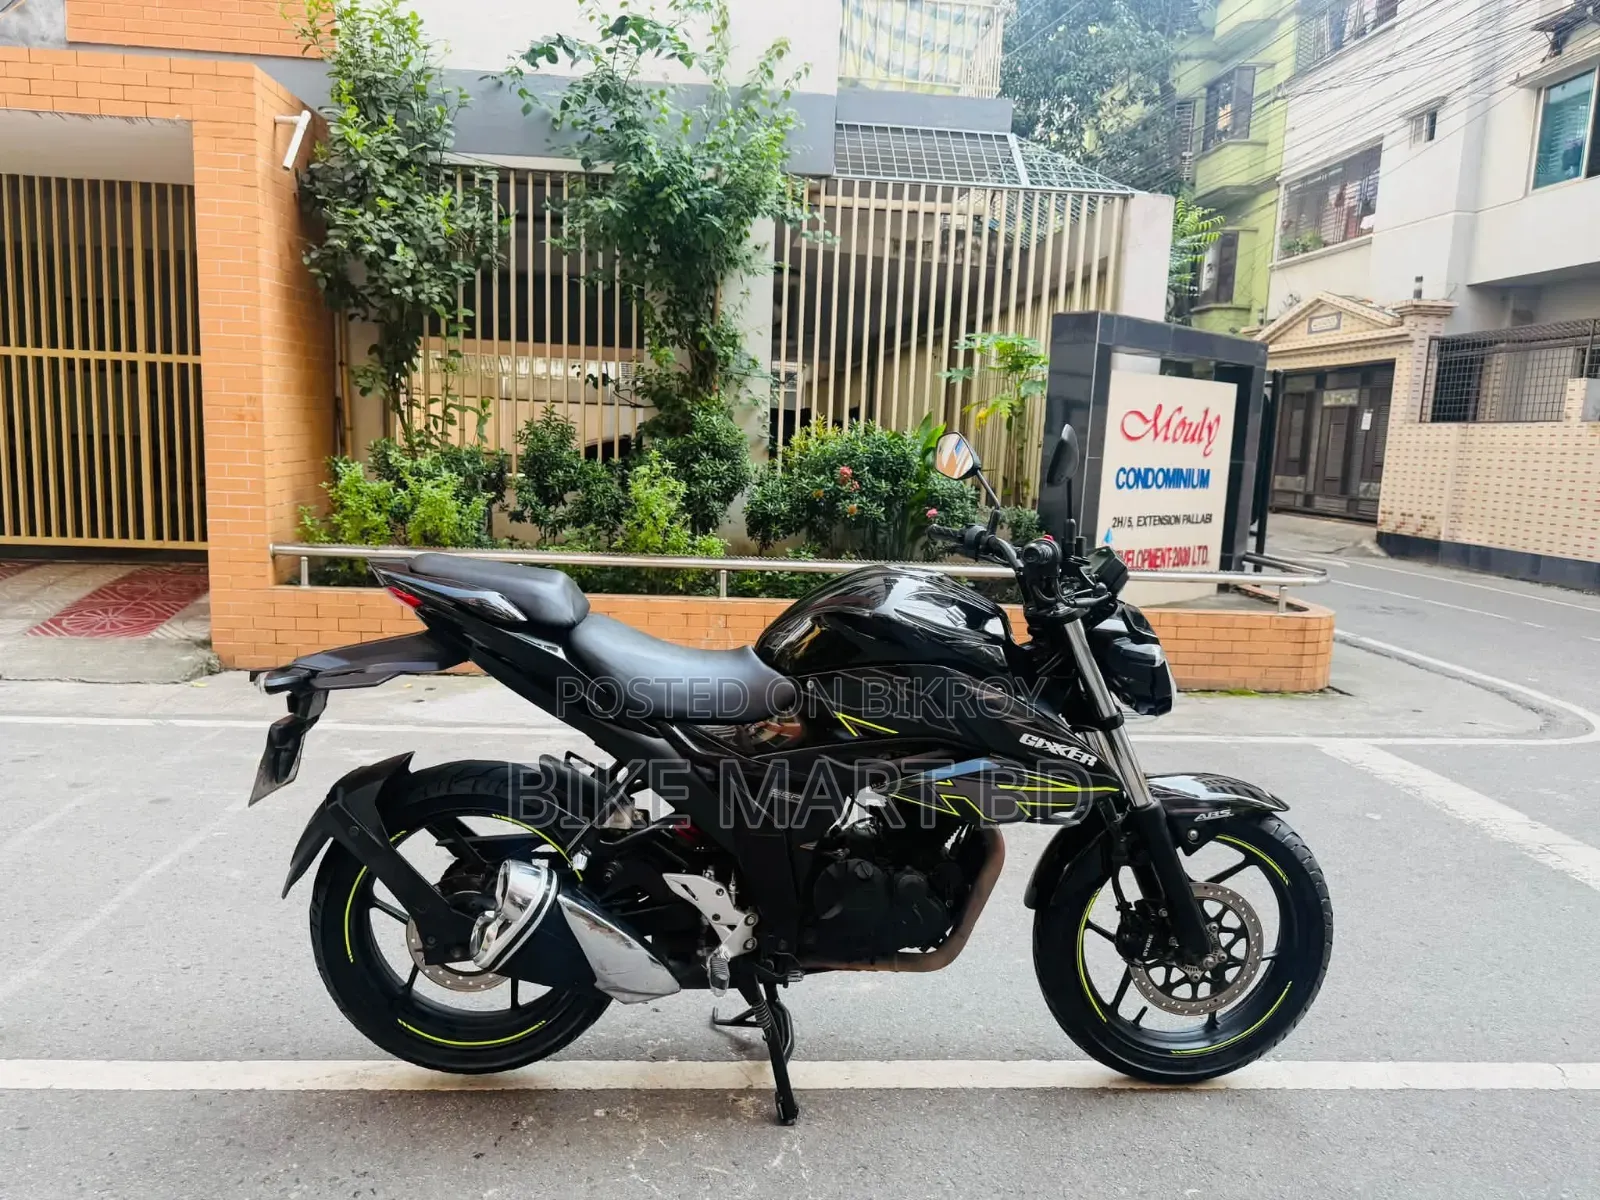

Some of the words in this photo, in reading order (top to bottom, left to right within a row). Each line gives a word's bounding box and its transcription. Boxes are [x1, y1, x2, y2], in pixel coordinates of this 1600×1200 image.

[1120, 403, 1220, 457] Mouly
[1115, 467, 1210, 489] CONDOMINIUM
[1137, 514, 1180, 527] EXTENSION
[1182, 513, 1212, 525] PALLABI
[1019, 733, 1098, 767] GIXXER
[1193, 809, 1234, 822] ABS
